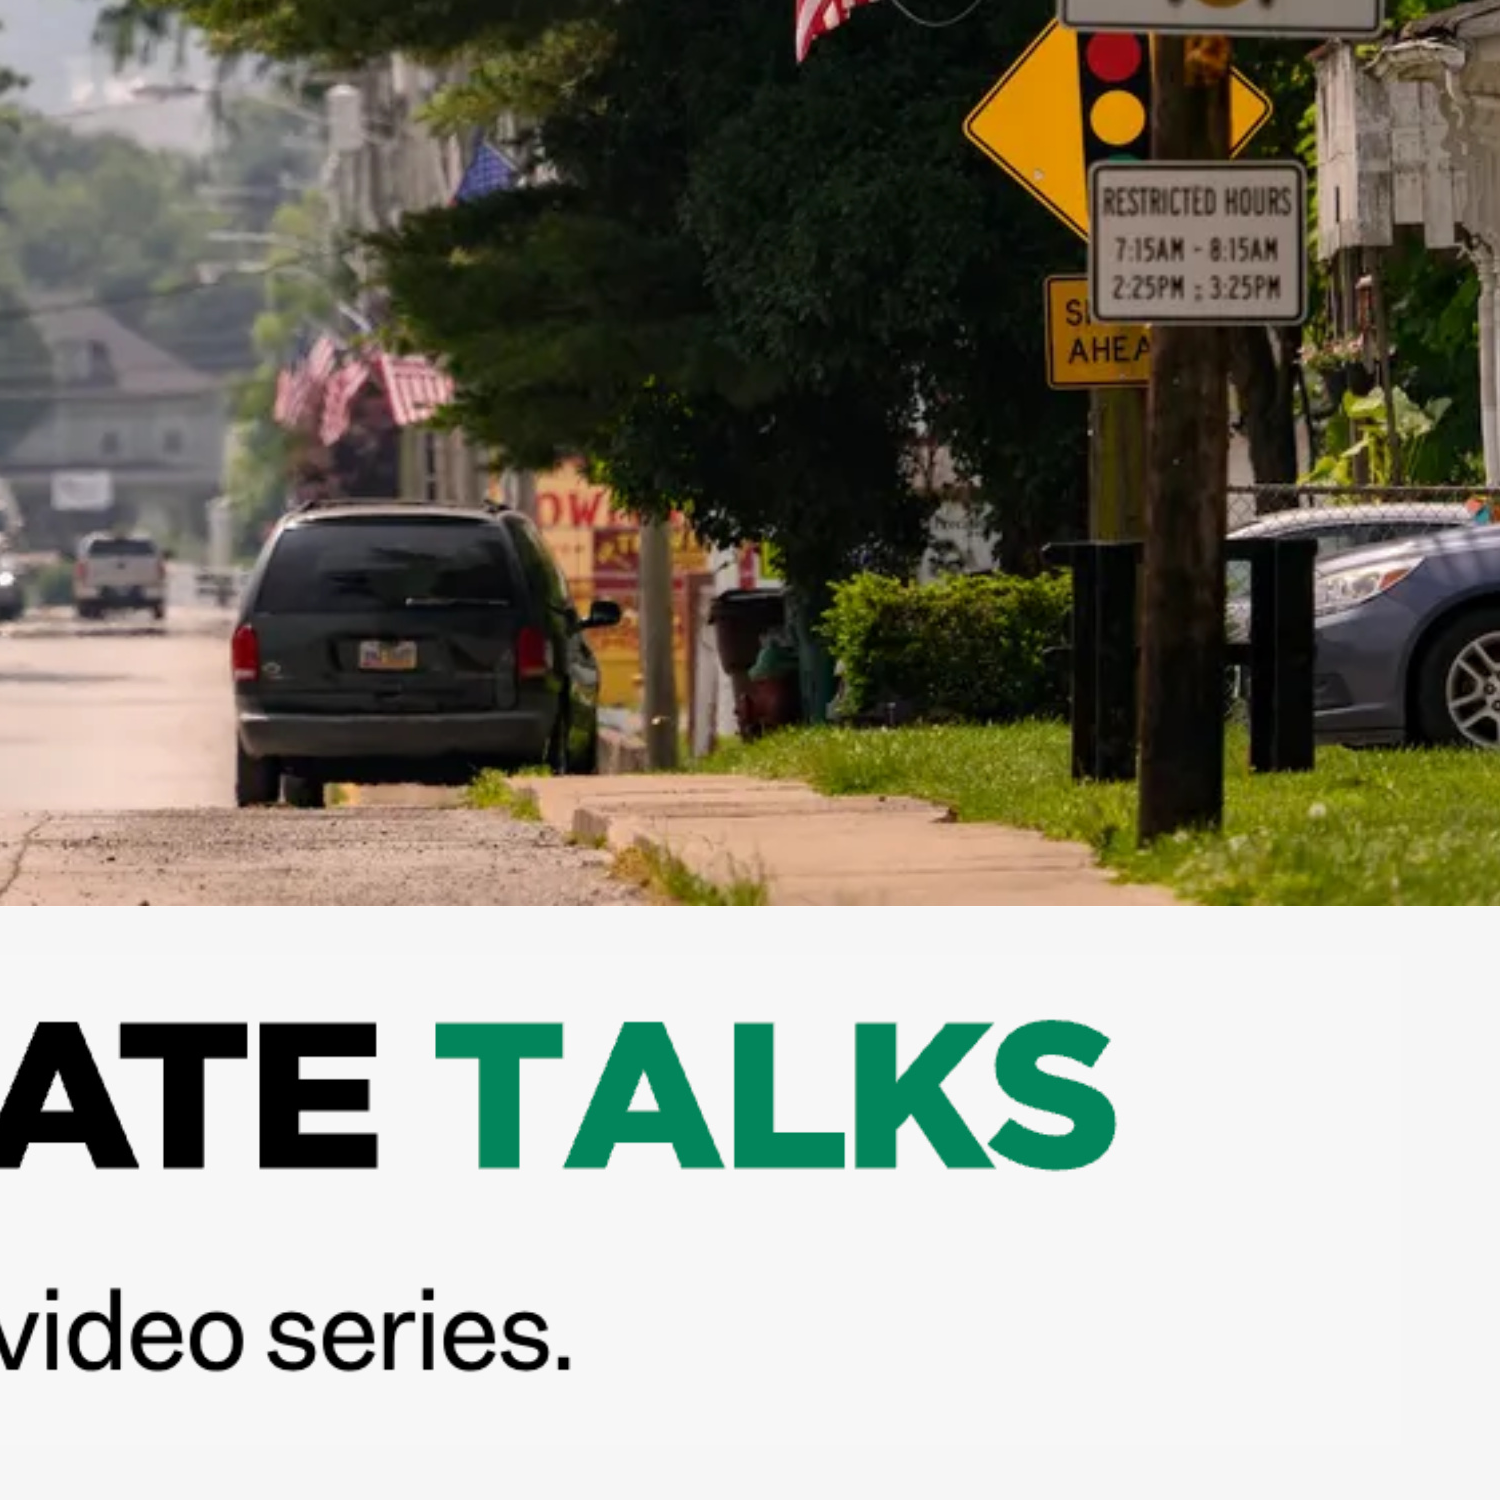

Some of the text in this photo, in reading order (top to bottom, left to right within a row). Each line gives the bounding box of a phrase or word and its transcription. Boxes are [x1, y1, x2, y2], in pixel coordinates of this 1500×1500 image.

[1103, 186, 1292, 217] RESTRICTED HOURS
[1115, 236, 1185, 263] 7:15AM
[1209, 236, 1278, 263] 8:15AM
[1113, 274, 1185, 300] 2:25PM
[1209, 274, 1281, 300] 3:25PM
